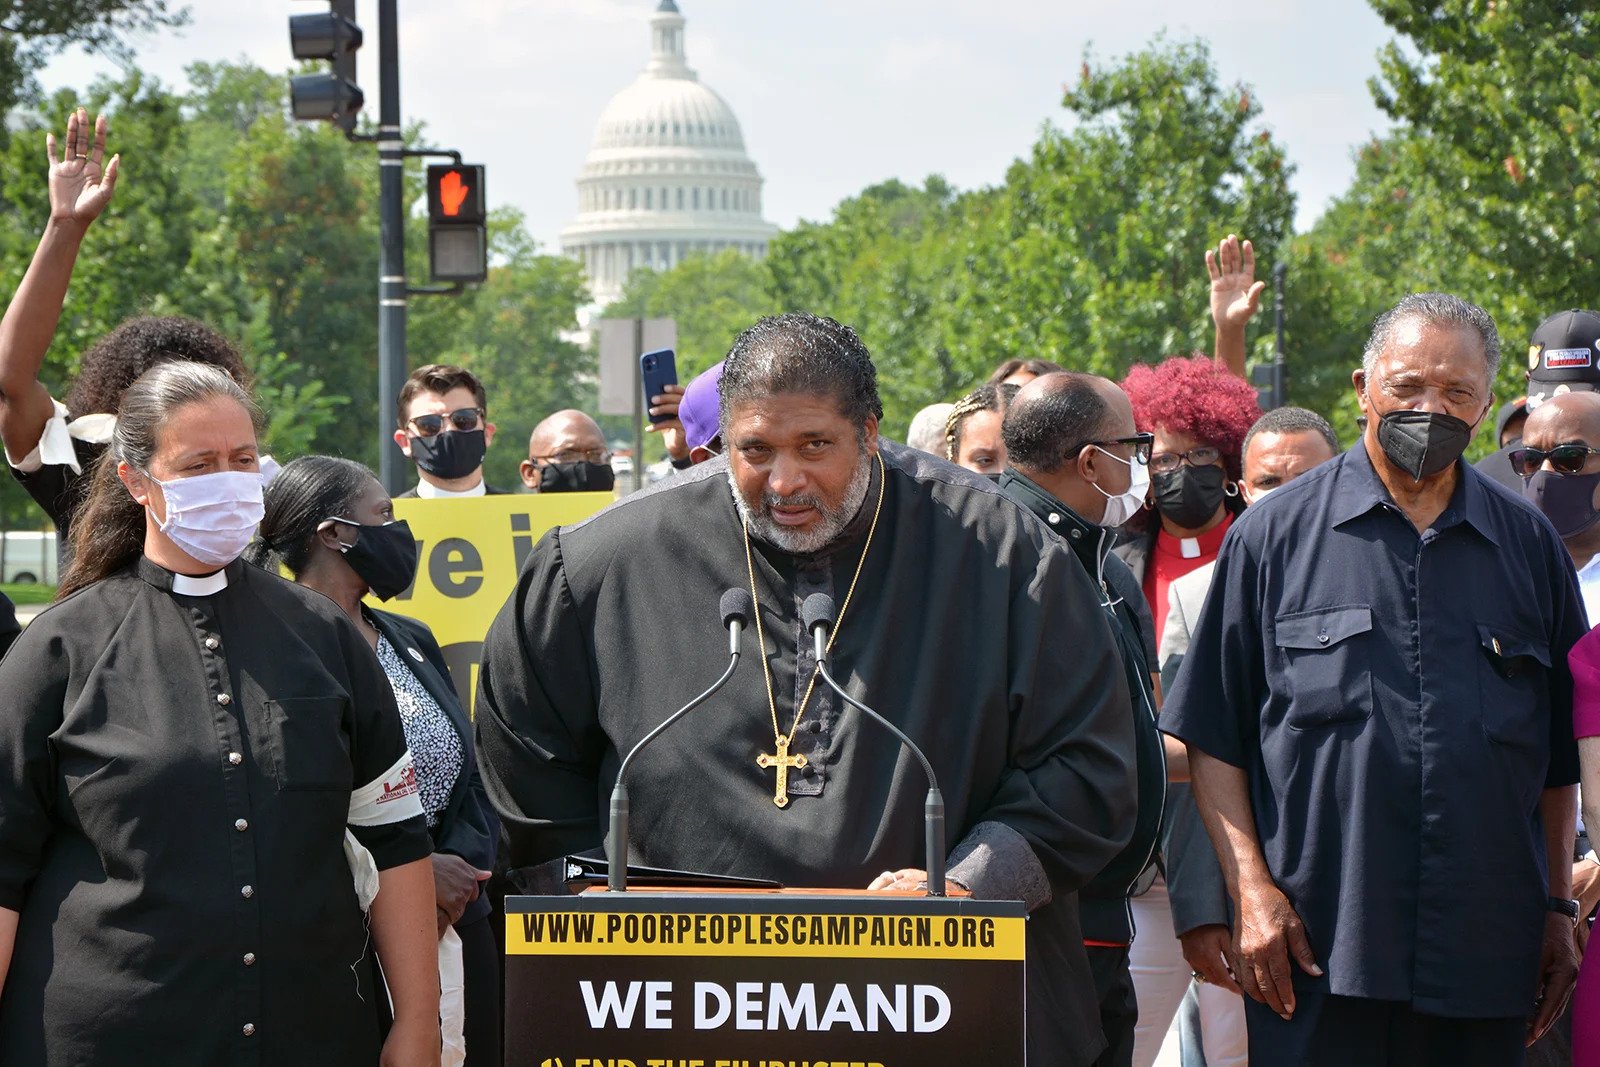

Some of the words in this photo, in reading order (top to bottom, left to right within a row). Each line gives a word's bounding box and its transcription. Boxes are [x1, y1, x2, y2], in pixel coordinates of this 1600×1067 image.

[522, 913, 996, 949] WWW.POORPEOPLESCAMPAIGN.ORG
[579, 980, 673, 1029] WE
[694, 981, 952, 1033] DEMAND
